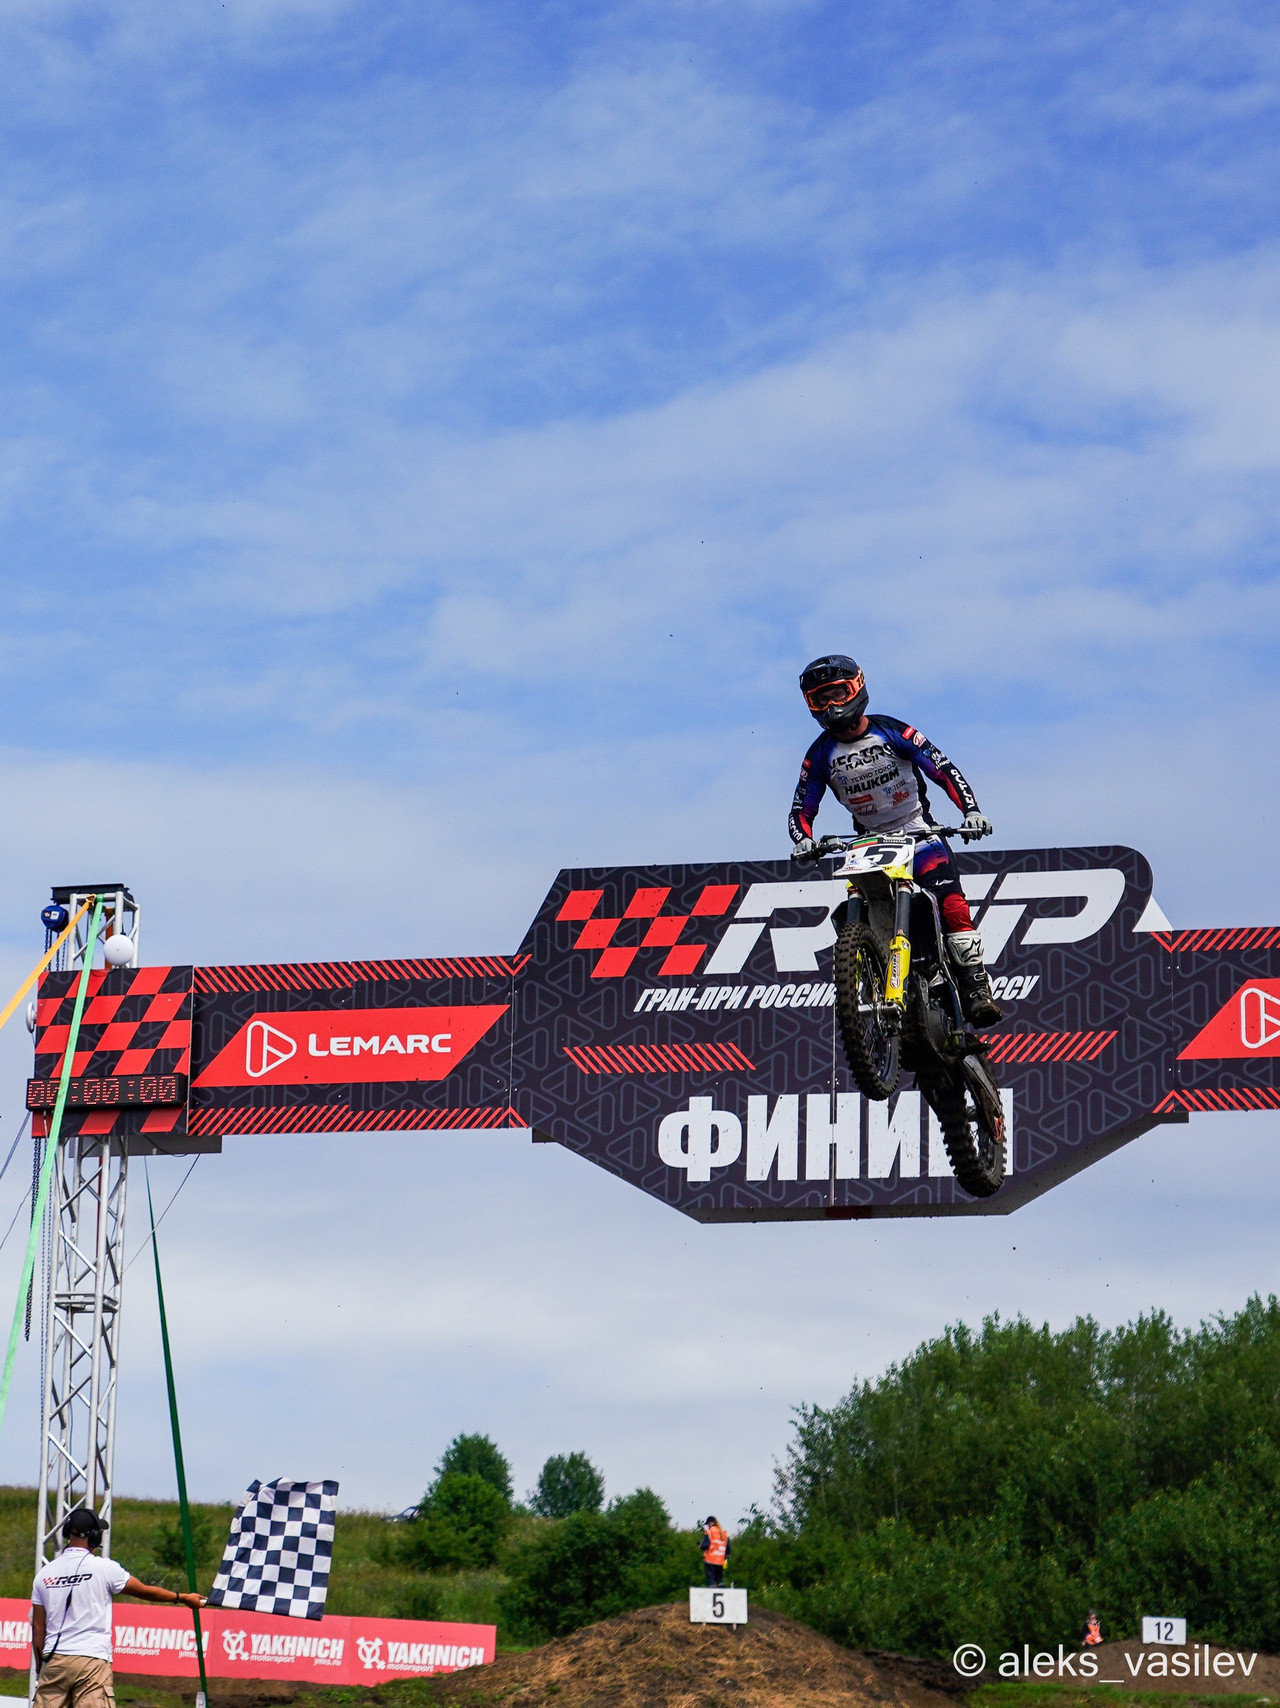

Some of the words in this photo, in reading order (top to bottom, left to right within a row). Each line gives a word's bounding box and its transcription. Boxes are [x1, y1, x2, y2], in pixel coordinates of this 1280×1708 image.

[863, 845, 903, 865] 5
[703, 868, 1126, 975] RP
[633, 984, 749, 1013] ГРАН-ПРИ
[308, 1033, 452, 1057] LEMARC
[56, 1574, 92, 1585] RGP
[712, 1593, 725, 1618] 5
[1154, 1621, 1174, 1641] 12
[251, 1634, 345, 1659] YAKHNICH
[387, 1642, 485, 1667] YAKHNICH
